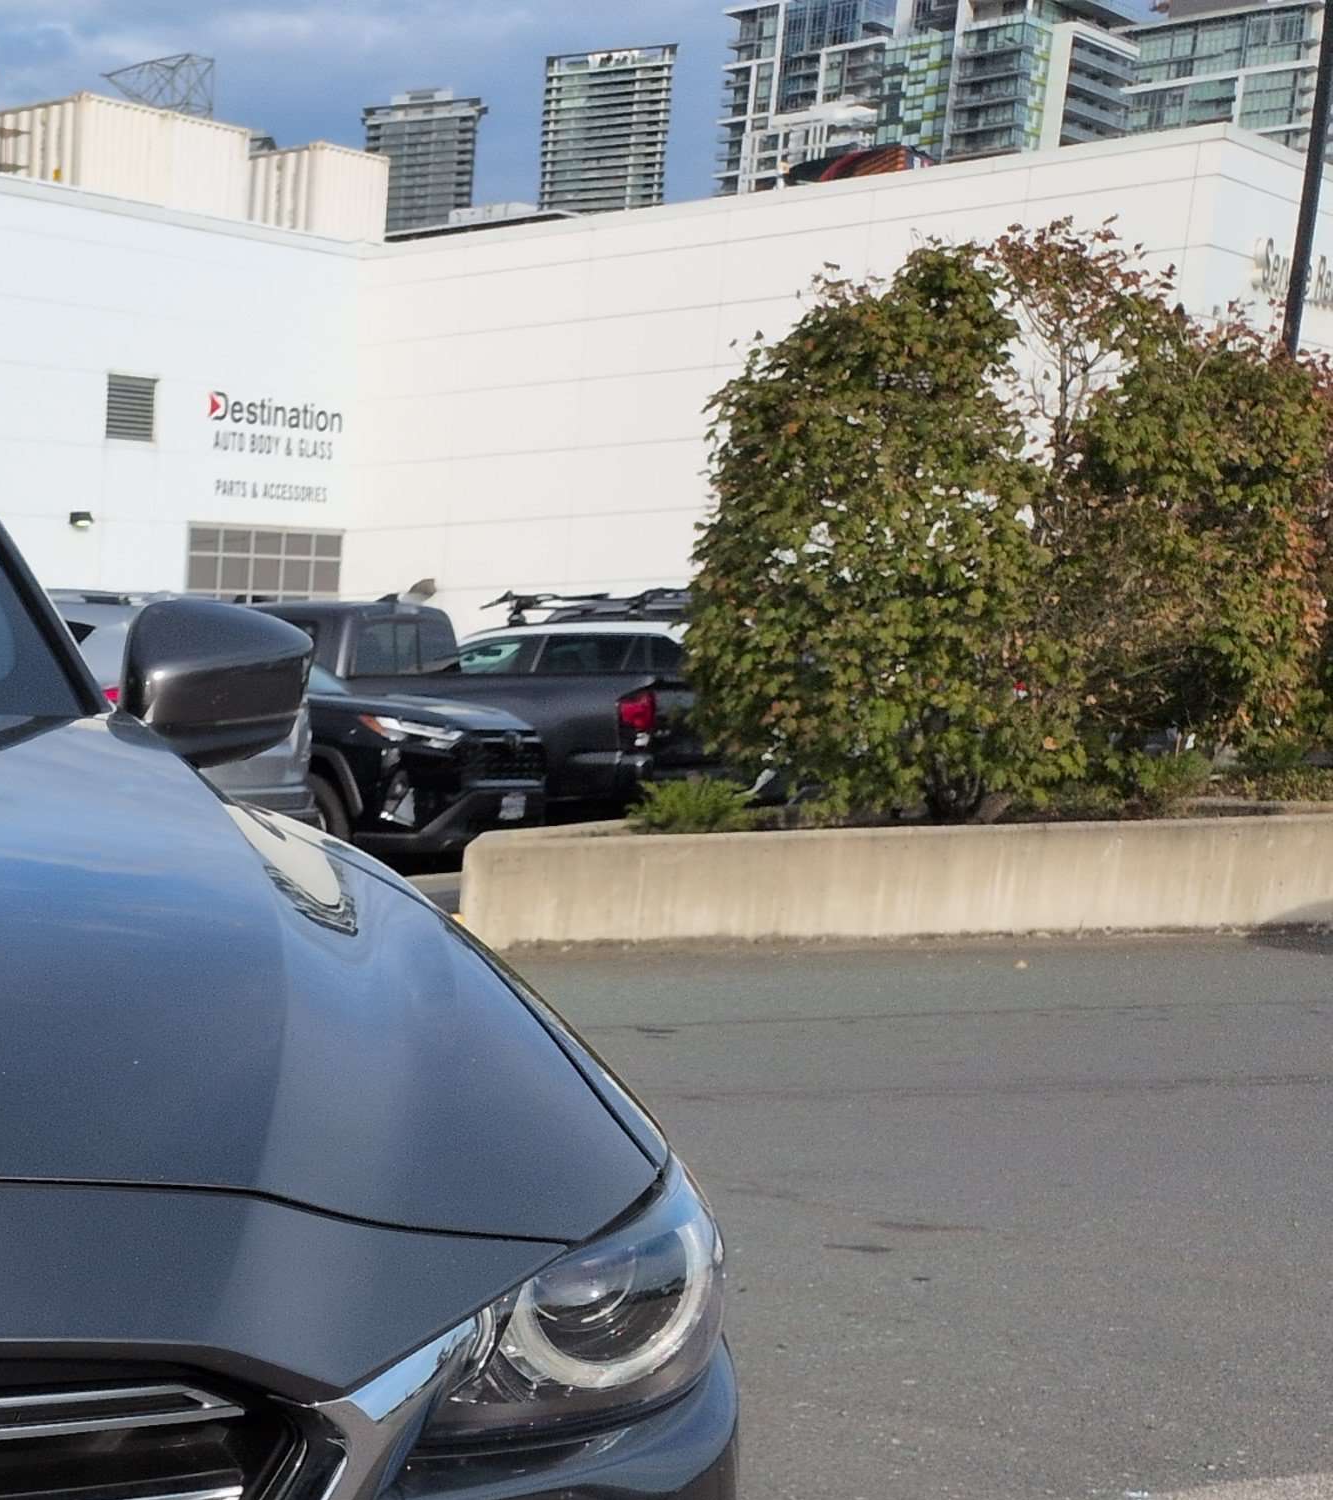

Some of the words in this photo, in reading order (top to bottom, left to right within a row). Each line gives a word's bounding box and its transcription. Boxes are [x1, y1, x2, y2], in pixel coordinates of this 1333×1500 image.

[209, 391, 343, 433] Destination
[213, 430, 245, 452] AUTO
[249, 433, 280, 454] BODY
[298, 438, 333, 460] GLASS
[214, 479, 247, 498] PARTS
[262, 483, 328, 502] ACCESSORIES
